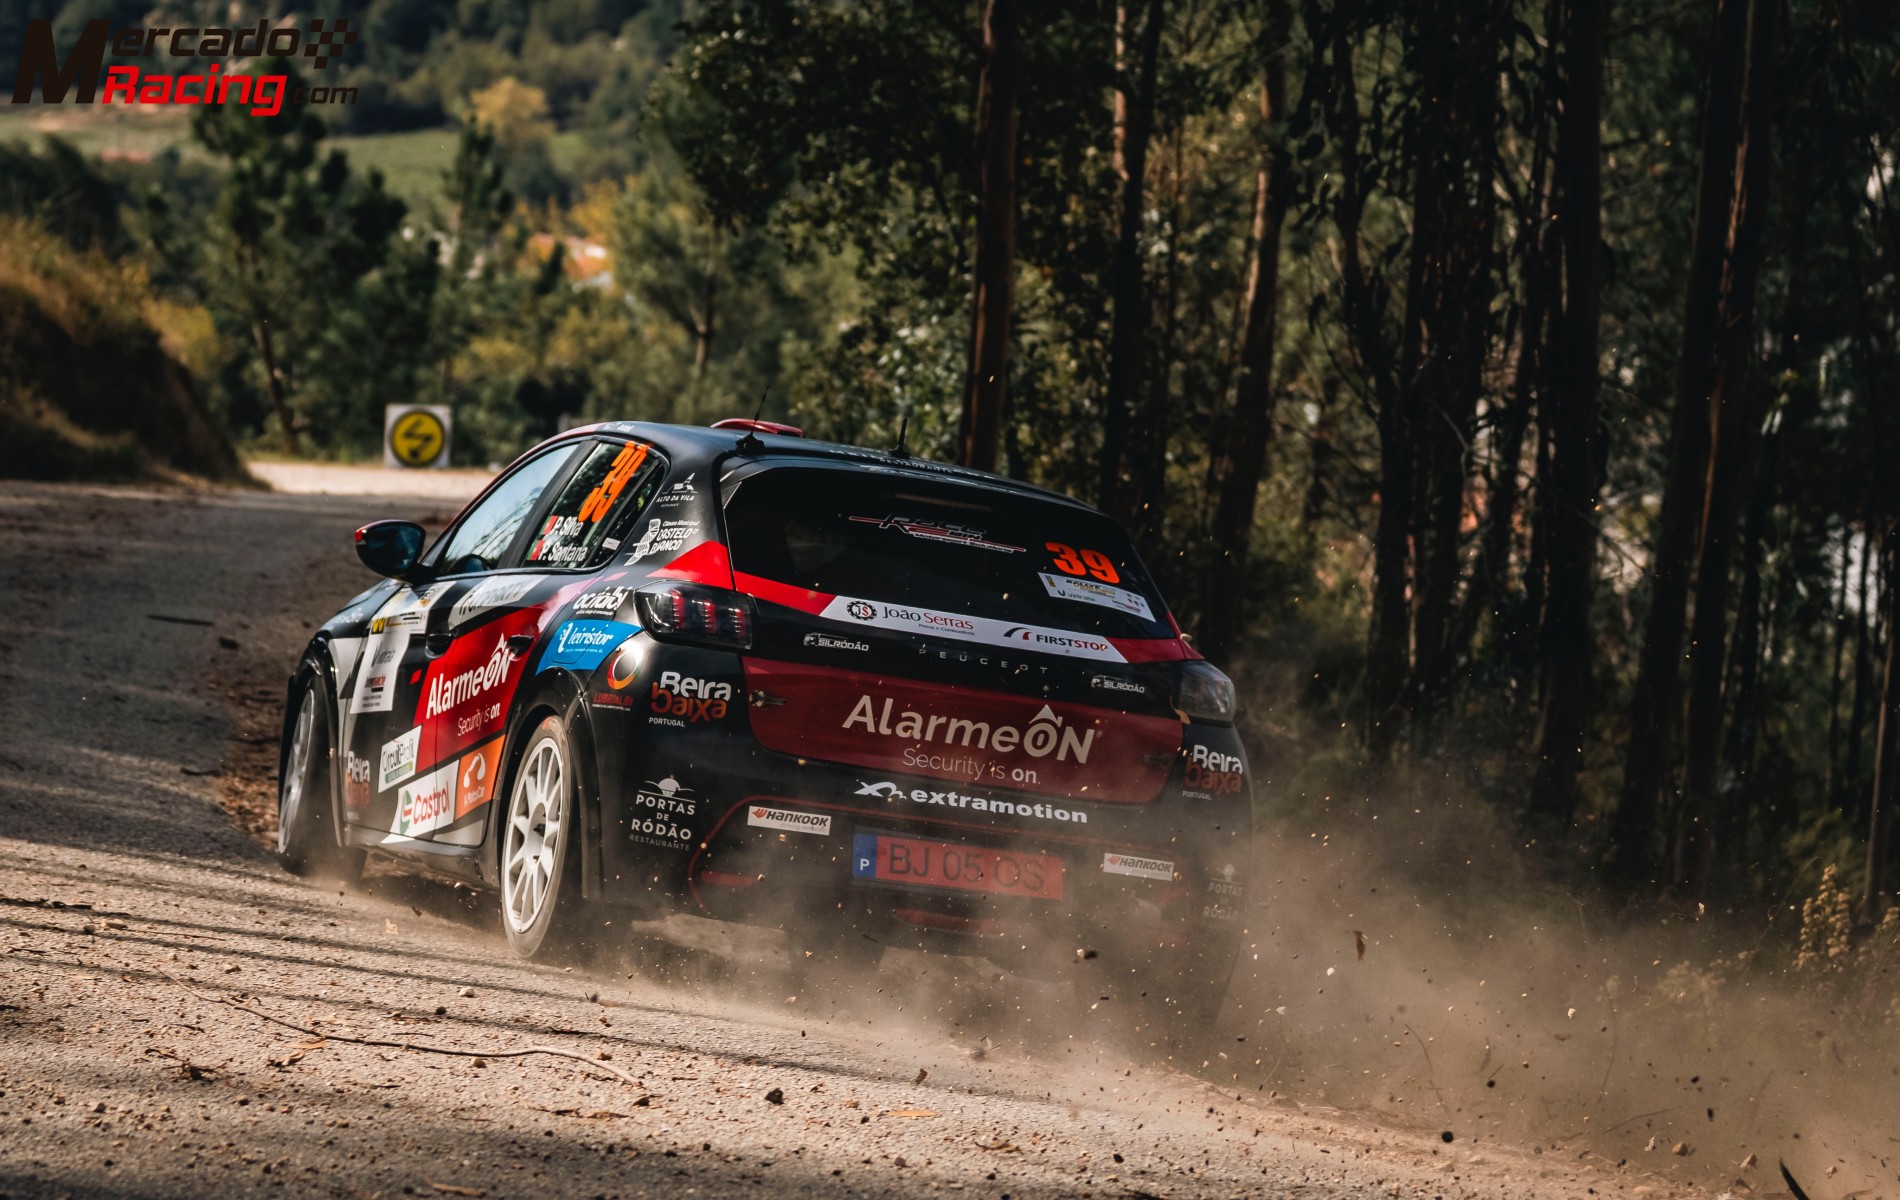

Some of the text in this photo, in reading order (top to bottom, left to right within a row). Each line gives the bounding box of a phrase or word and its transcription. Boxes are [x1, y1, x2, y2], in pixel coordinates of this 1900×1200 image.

[578, 441, 647, 522] 39
[559, 516, 584, 537] Silva
[548, 541, 588, 561] Santana
[1045, 542, 1120, 583] 39
[882, 606, 922, 622] João
[923, 612, 975, 630] Serras
[1036, 634, 1108, 651] FIRSTSTOP
[426, 633, 511, 720] AlarmeON
[660, 671, 732, 702] Beira
[650, 681, 728, 723] baixa
[457, 709, 483, 737] Security
[649, 717, 686, 727] PORTUGAL
[842, 695, 1095, 764] AlarmeON
[903, 749, 985, 779] Security
[991, 762, 1006, 779] is
[1193, 745, 1243, 774] Beira
[413, 781, 450, 825] Castrol
[636, 794, 696, 815] PORTAS
[656, 812, 670, 821] DE
[910, 788, 1088, 824] extramotion
[629, 834, 690, 851] RESTAURANTE
[631, 818, 692, 840] RÓDÃO
[859, 843, 1044, 892] P BJ 05 OS
